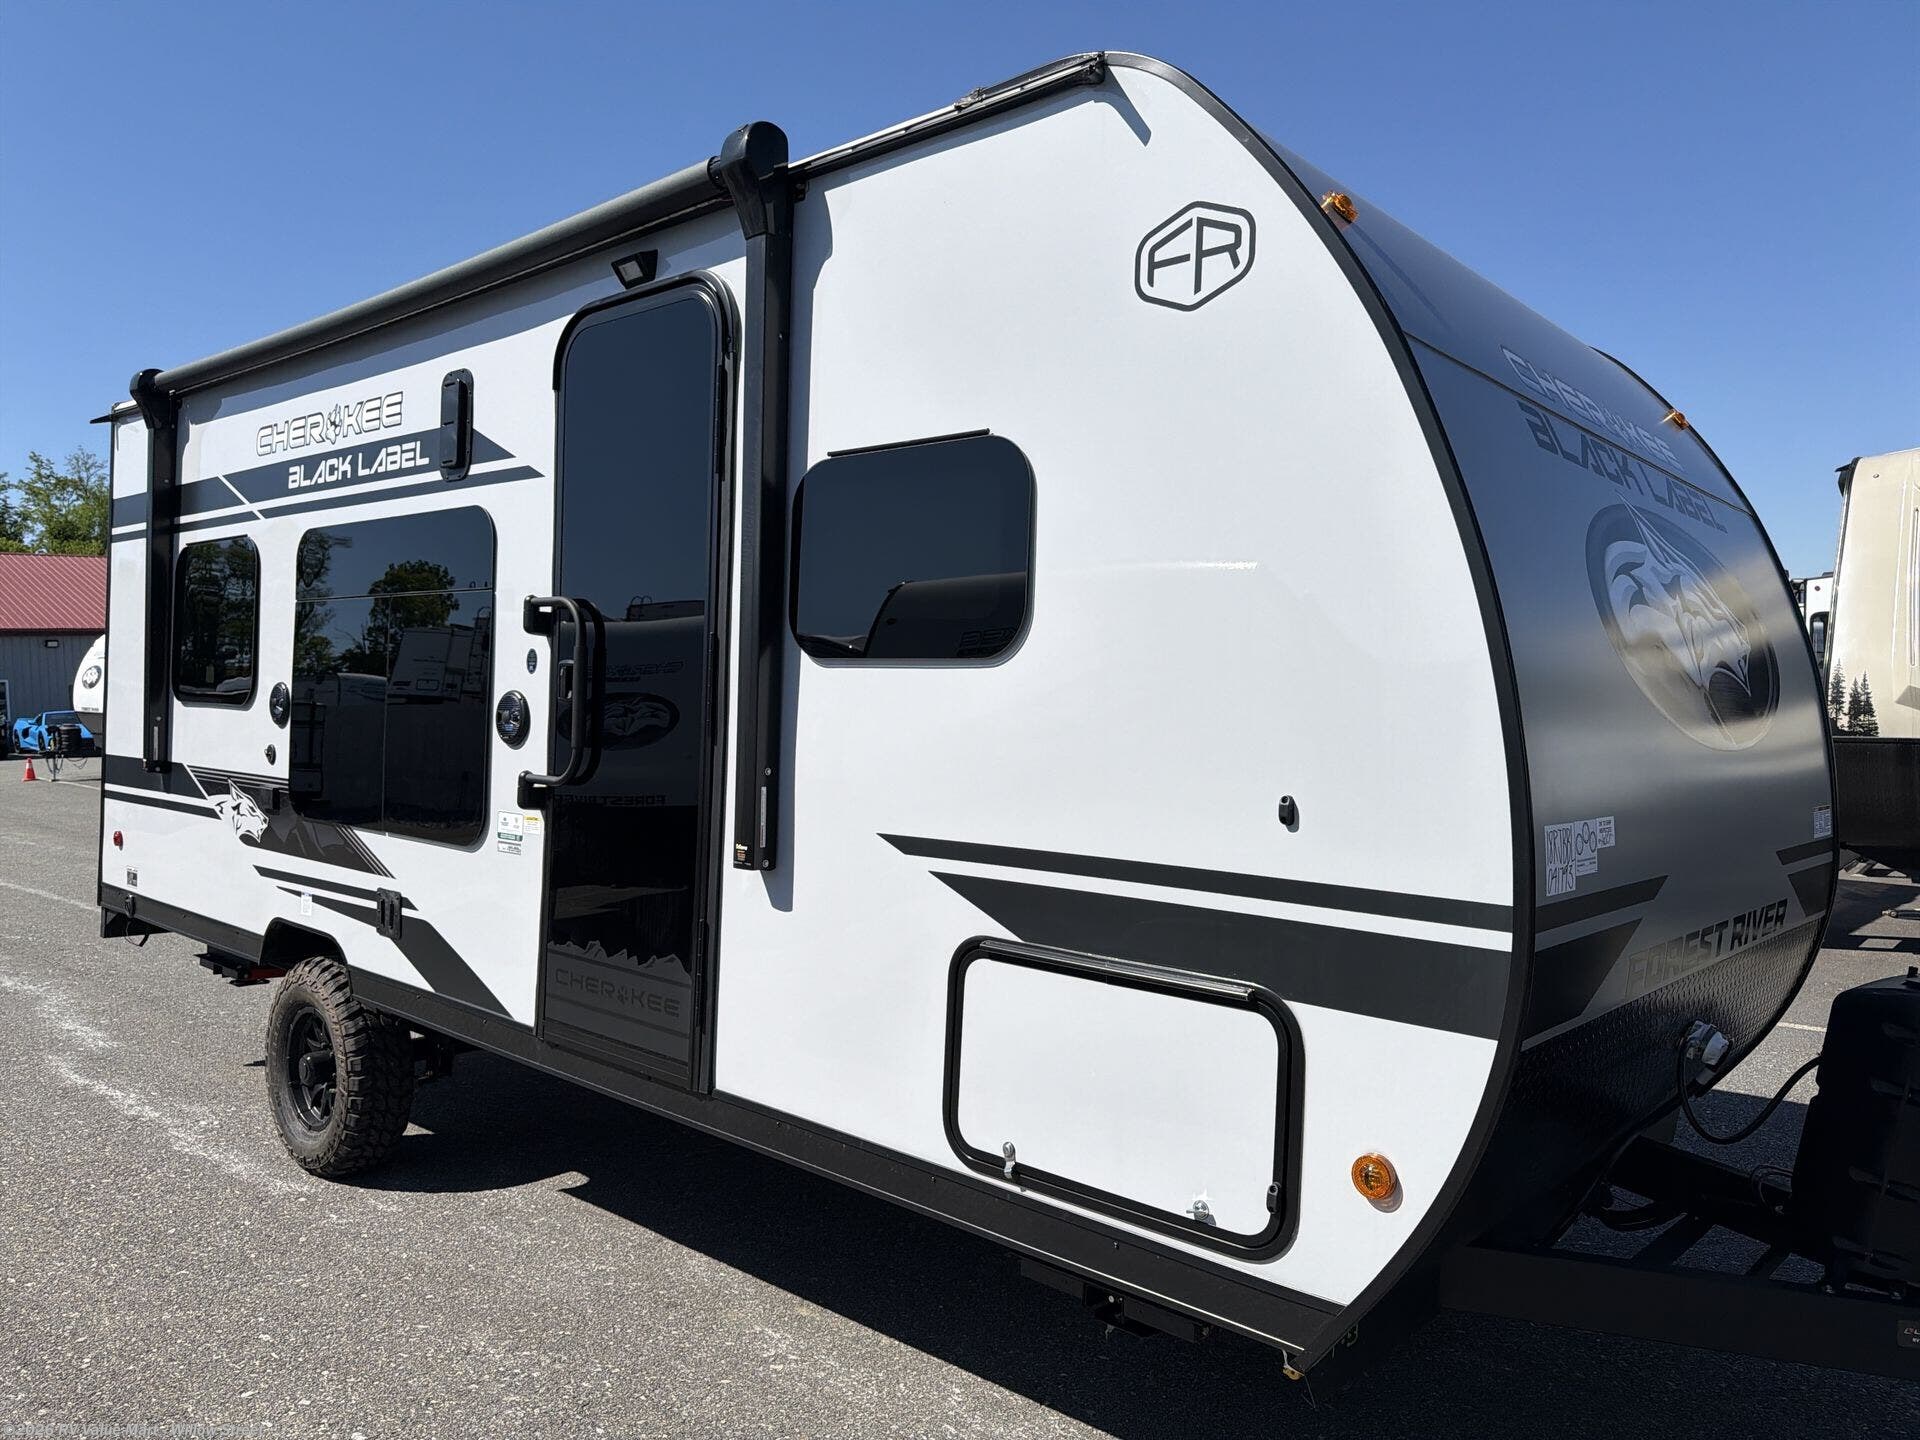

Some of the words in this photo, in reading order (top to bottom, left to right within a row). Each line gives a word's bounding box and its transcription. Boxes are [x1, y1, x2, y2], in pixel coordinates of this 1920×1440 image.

[288, 454, 353, 490] BLACK
[357, 440, 430, 477] LABEL
[1516, 399, 1644, 496] BLACK
[1637, 462, 1728, 534] LABEL
[1626, 921, 1729, 996] FOREST
[1730, 898, 1788, 951] RIVER
